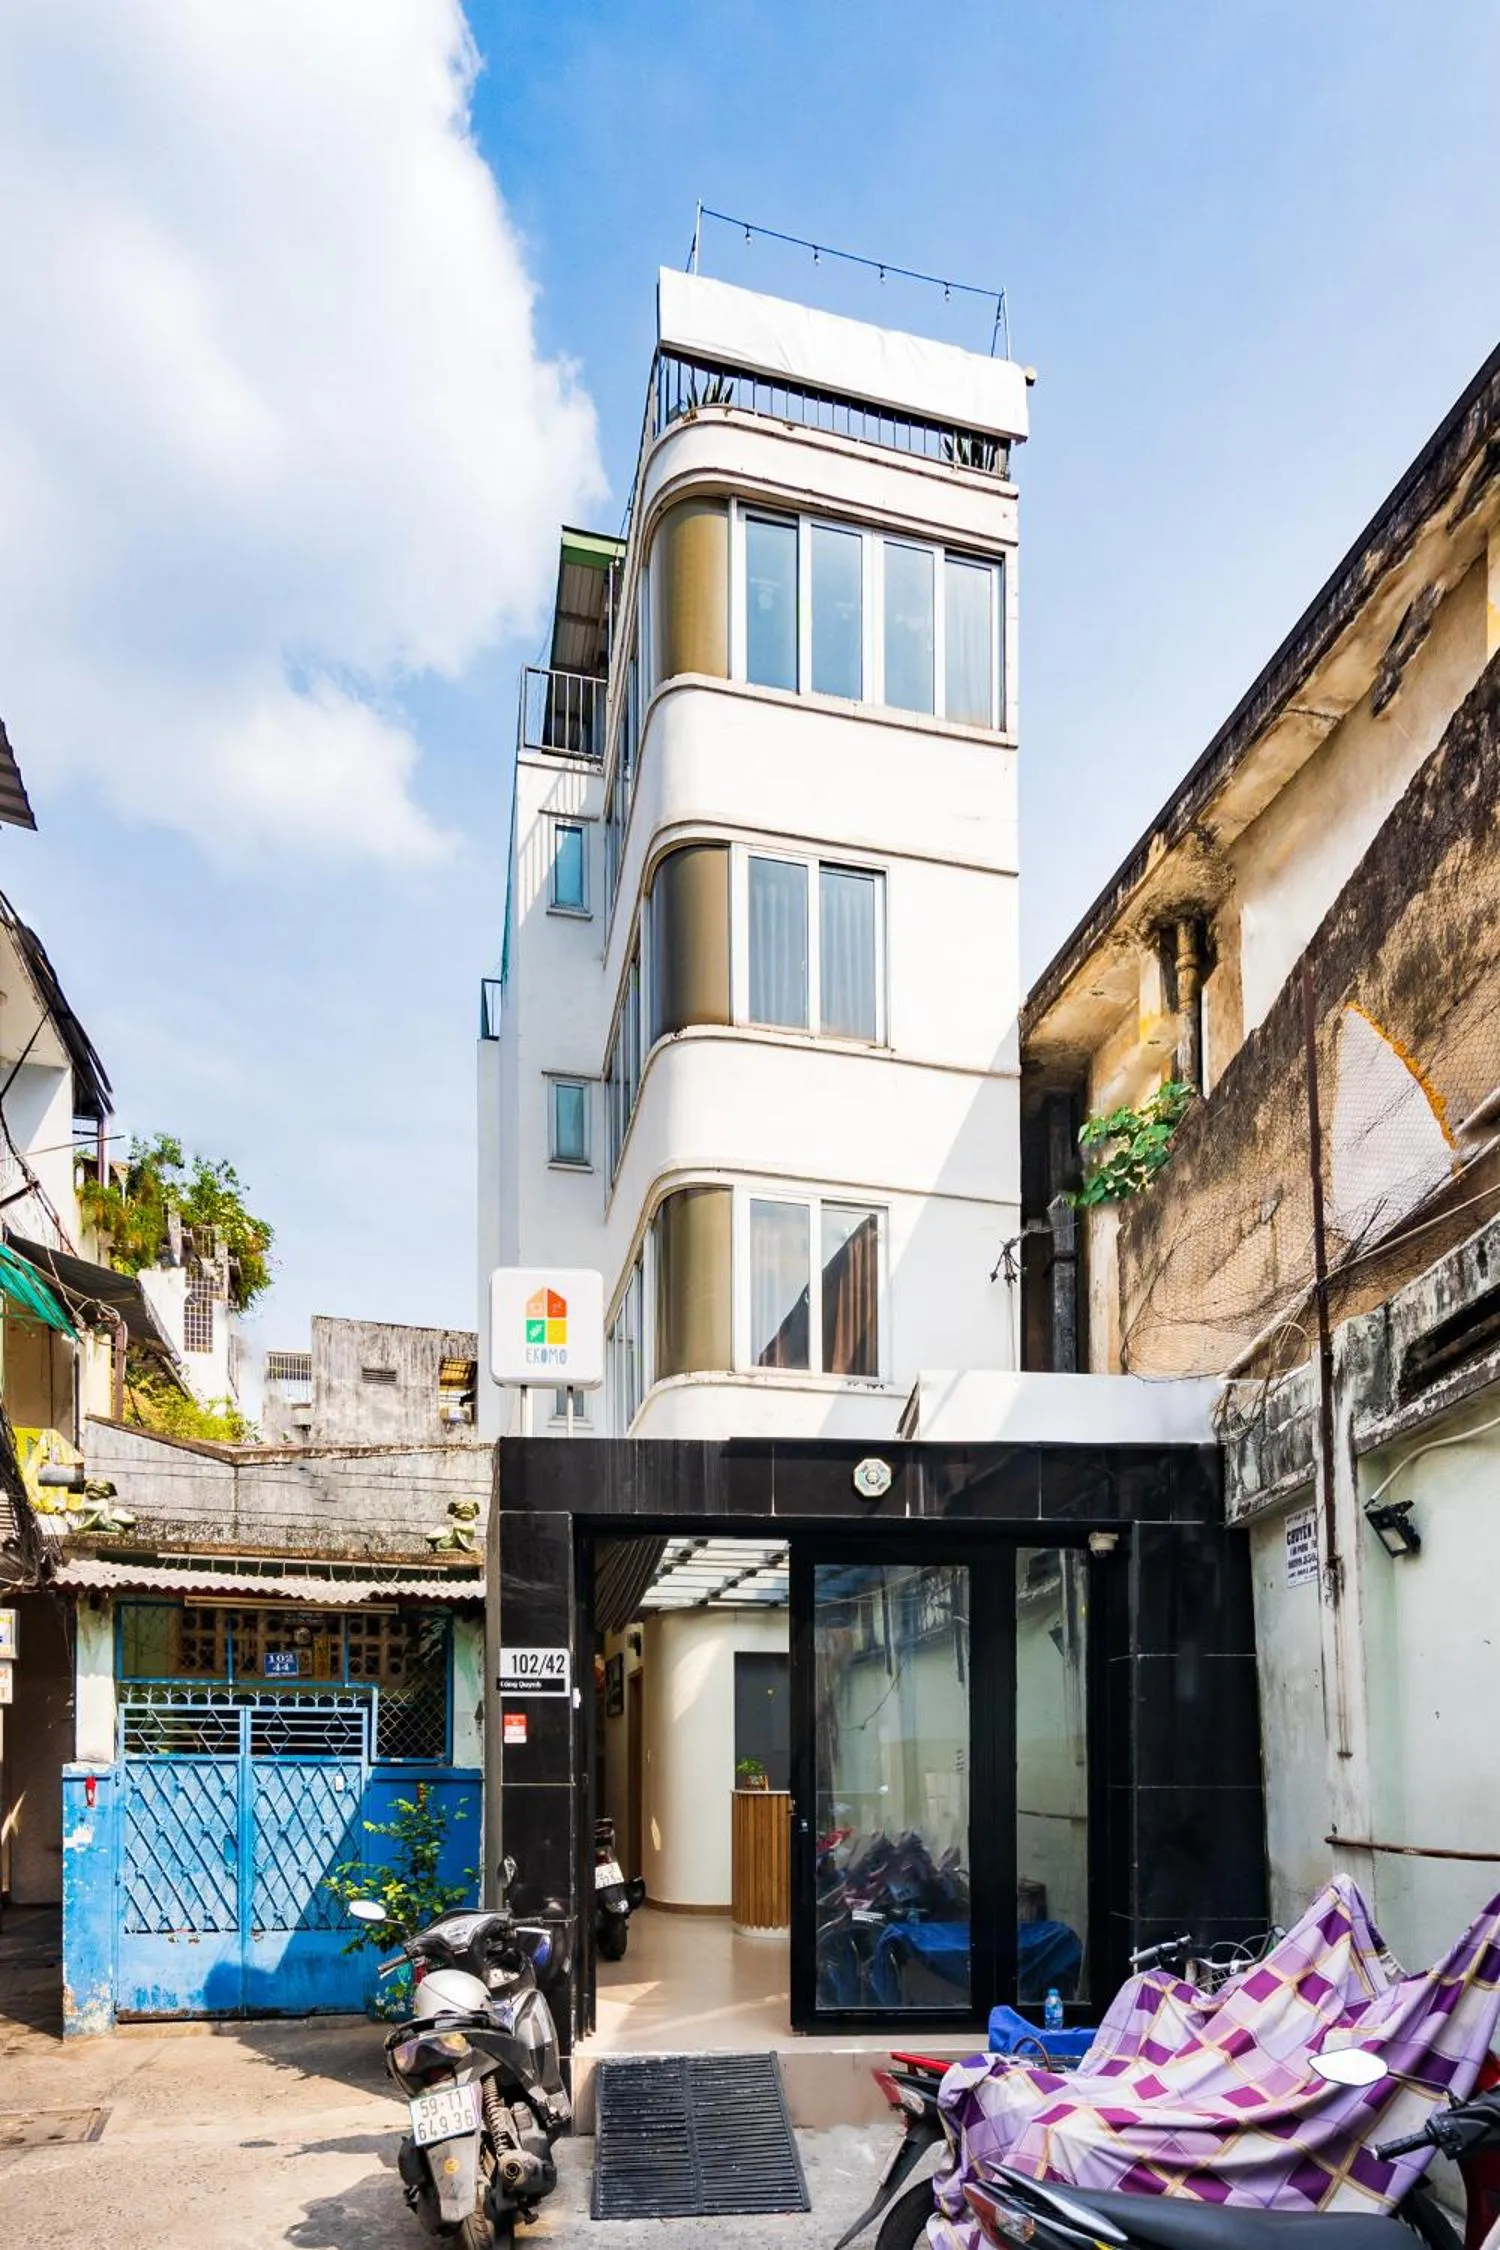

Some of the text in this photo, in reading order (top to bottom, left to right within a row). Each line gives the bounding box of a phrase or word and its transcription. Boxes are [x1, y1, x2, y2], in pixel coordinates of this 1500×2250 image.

[526, 1348, 568, 1364] EKOMO
[269, 1654, 293, 1663] 102
[512, 1654, 565, 1675] 102/42
[273, 1662, 290, 1672] 44
